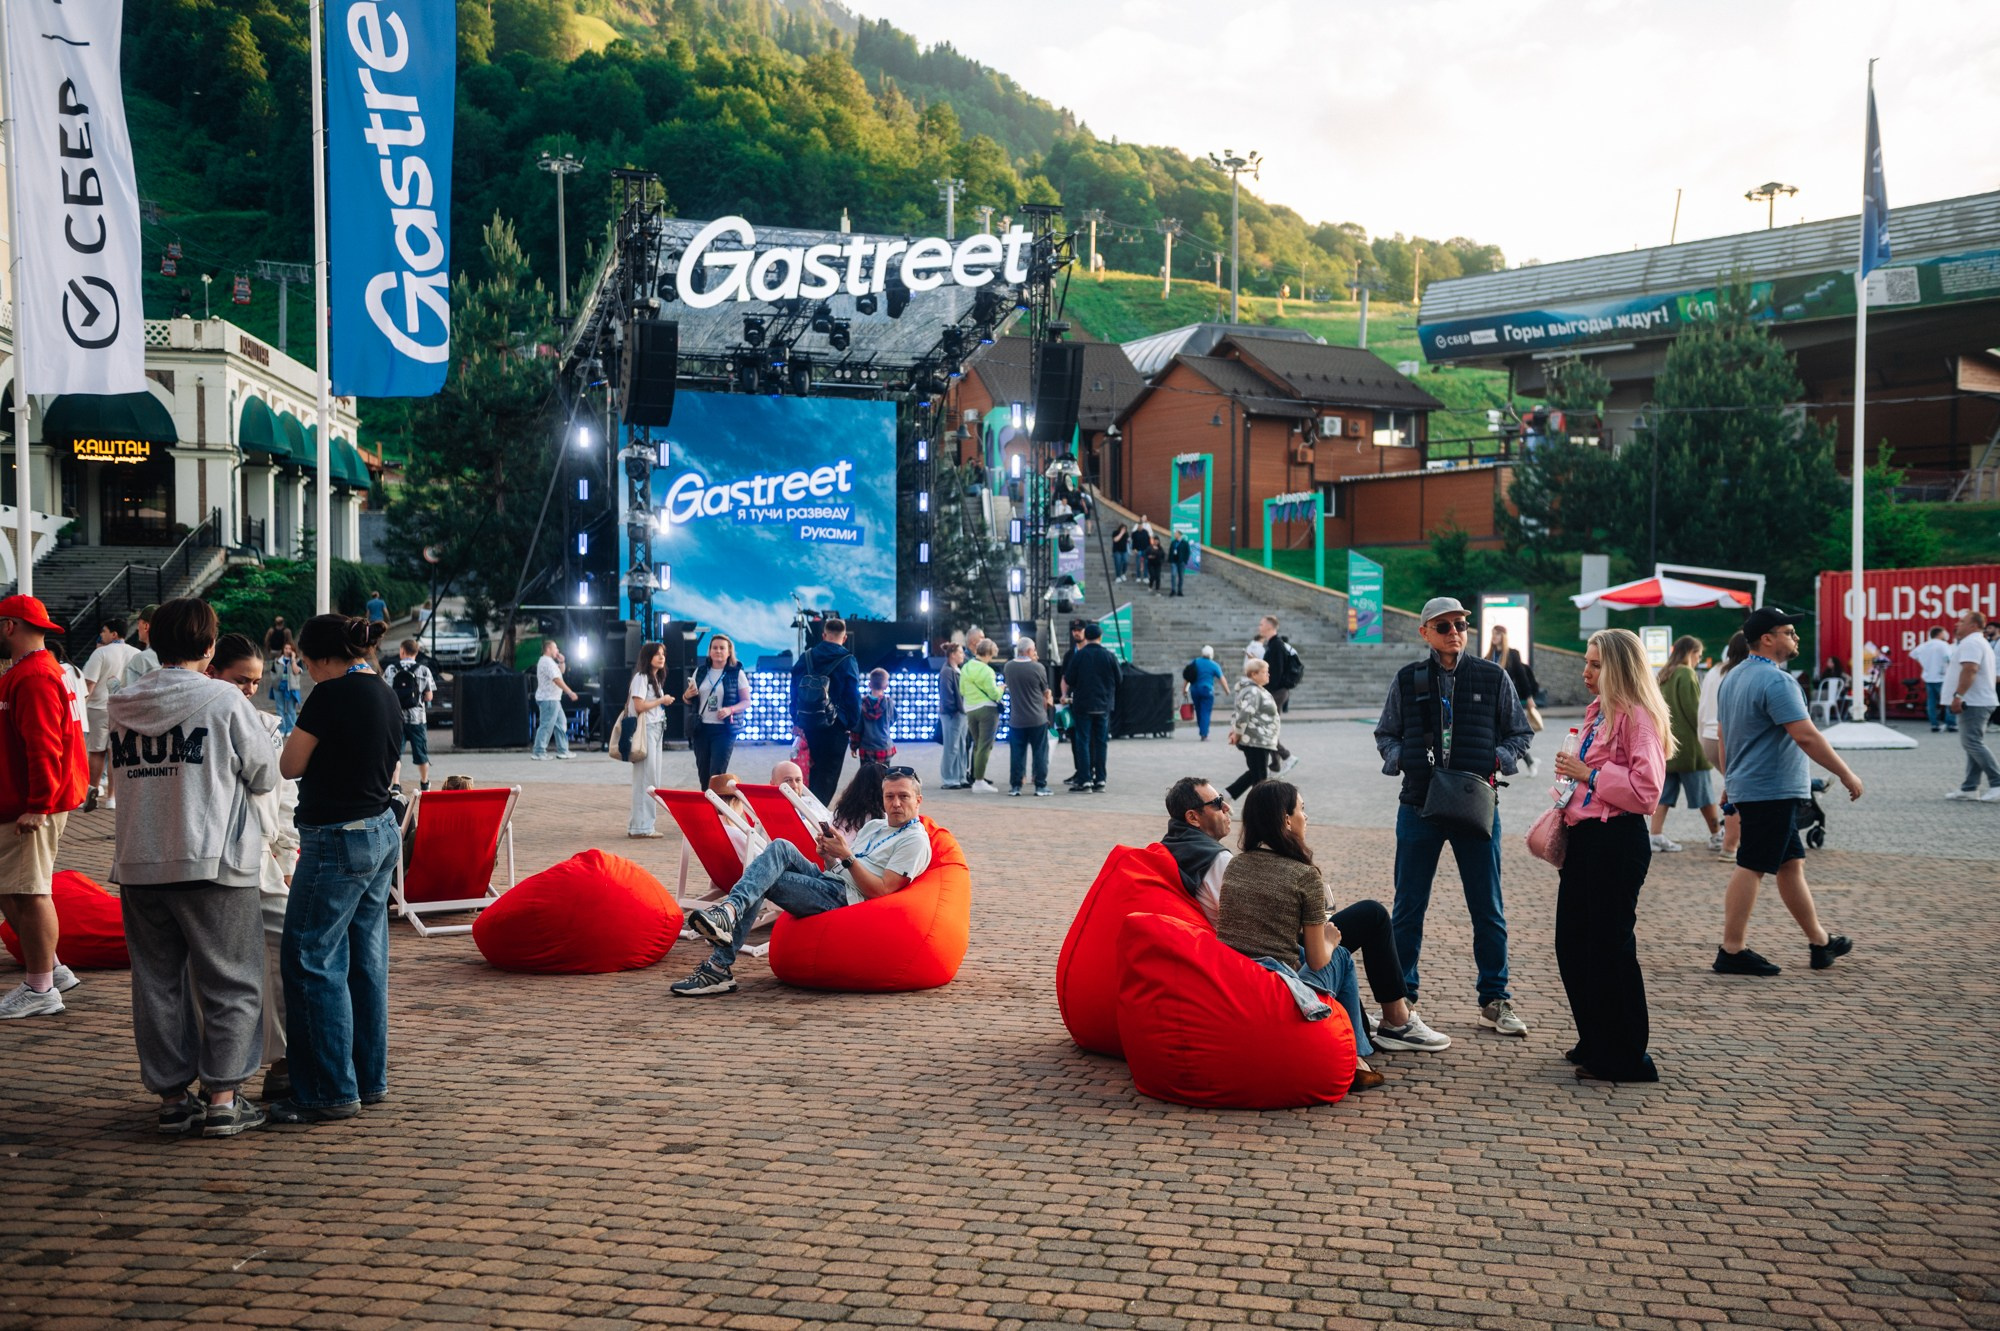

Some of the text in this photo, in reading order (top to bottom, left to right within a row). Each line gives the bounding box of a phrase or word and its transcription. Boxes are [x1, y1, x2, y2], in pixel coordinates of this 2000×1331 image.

[58, 77, 106, 254] СБЕР
[347, 0, 450, 364] Gastre
[676, 215, 1034, 309] Gastreet
[1503, 324, 1545, 343] Горы
[1549, 318, 1614, 336] выгоды
[1617, 305, 1670, 330] ждут!
[73, 438, 151, 456] КАШТАН
[665, 459, 853, 524] Gastreet
[738, 507, 850, 522] я тучи разведу
[800, 525, 857, 541] руками
[1844, 582, 1997, 621] OLDSCH
[109, 725, 208, 769] MUM
[127, 766, 179, 779] COMMUNITY
